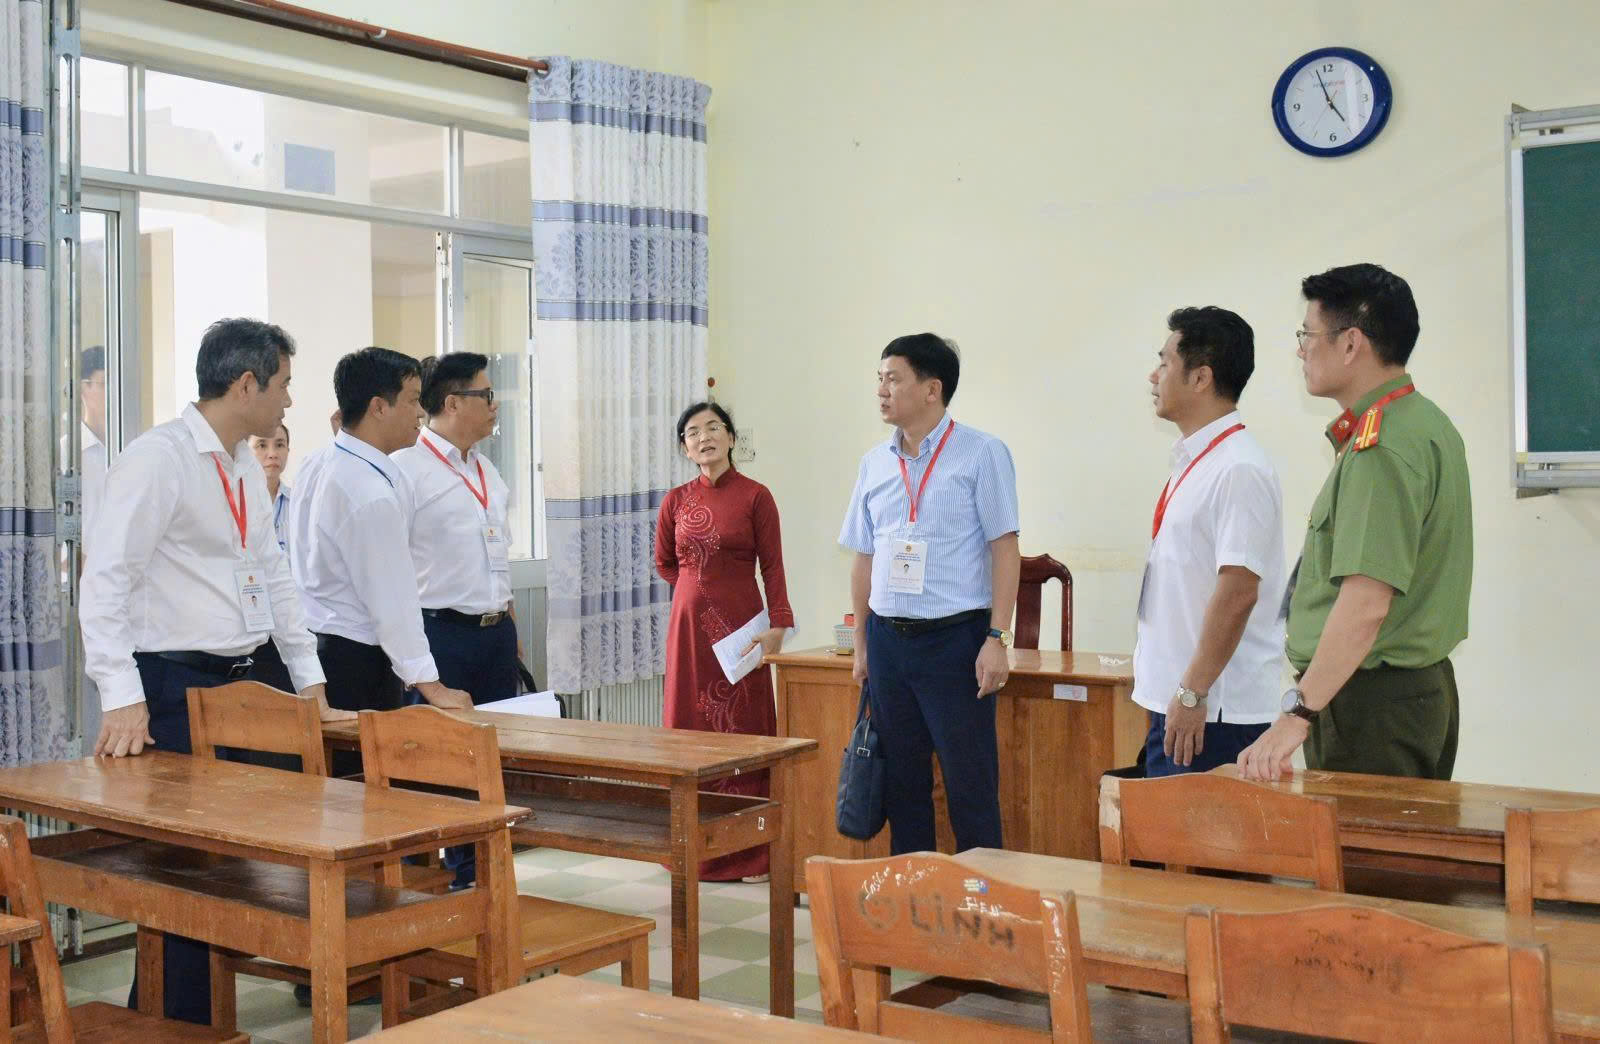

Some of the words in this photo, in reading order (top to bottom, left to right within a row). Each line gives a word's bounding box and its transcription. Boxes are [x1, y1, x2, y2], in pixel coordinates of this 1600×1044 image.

[1322, 64, 1334, 73] 12
[1362, 93, 1369, 103] 3
[1293, 103, 1301, 112] 9
[1329, 132, 1337, 142] 6
